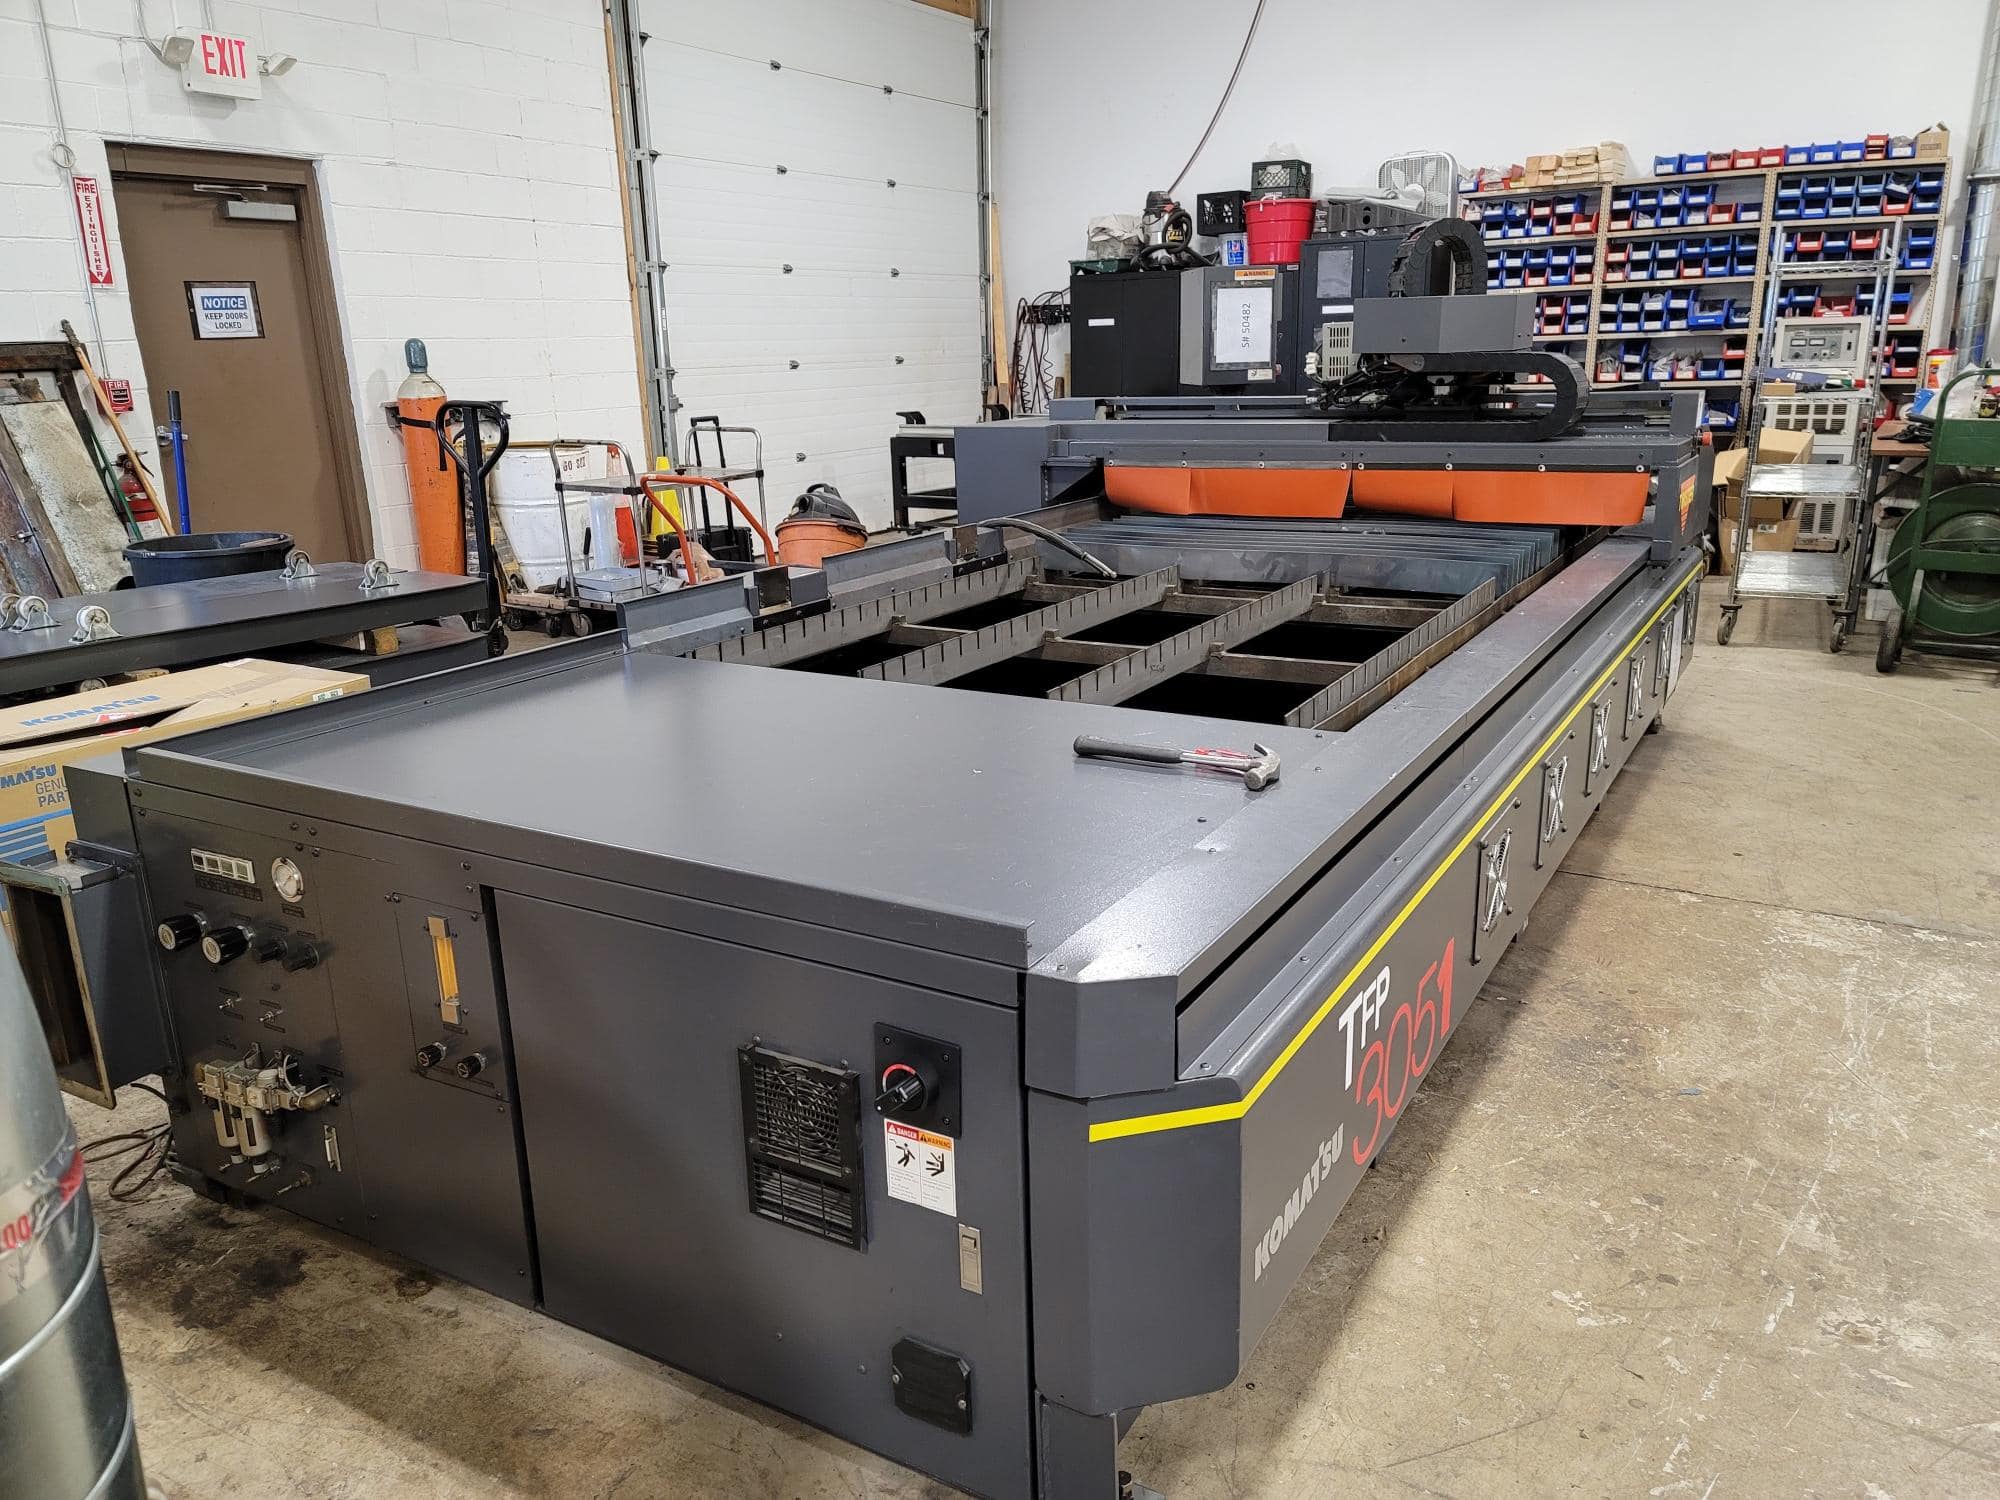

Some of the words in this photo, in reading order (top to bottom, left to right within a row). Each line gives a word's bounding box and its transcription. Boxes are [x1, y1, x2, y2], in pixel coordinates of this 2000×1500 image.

[201, 34, 246, 79] EXIT
[76, 183, 96, 194] FIRE
[84, 196, 104, 278] EXTINGUISHER
[204, 297, 246, 309] NOTICE
[205, 312, 224, 320] KEEP
[225, 312, 249, 320] DOORS
[1241, 303, 1251, 334] 50482
[215, 321, 242, 329] LOCKED
[19, 694, 161, 727] KOMATSU
[1338, 965, 1391, 1091] TFP
[1352, 937, 1455, 1165] 3051
[896, 1126, 918, 1139] DANGER
[927, 1134, 952, 1149] WARNING
[1254, 1122, 1344, 1282] KOMATSU
